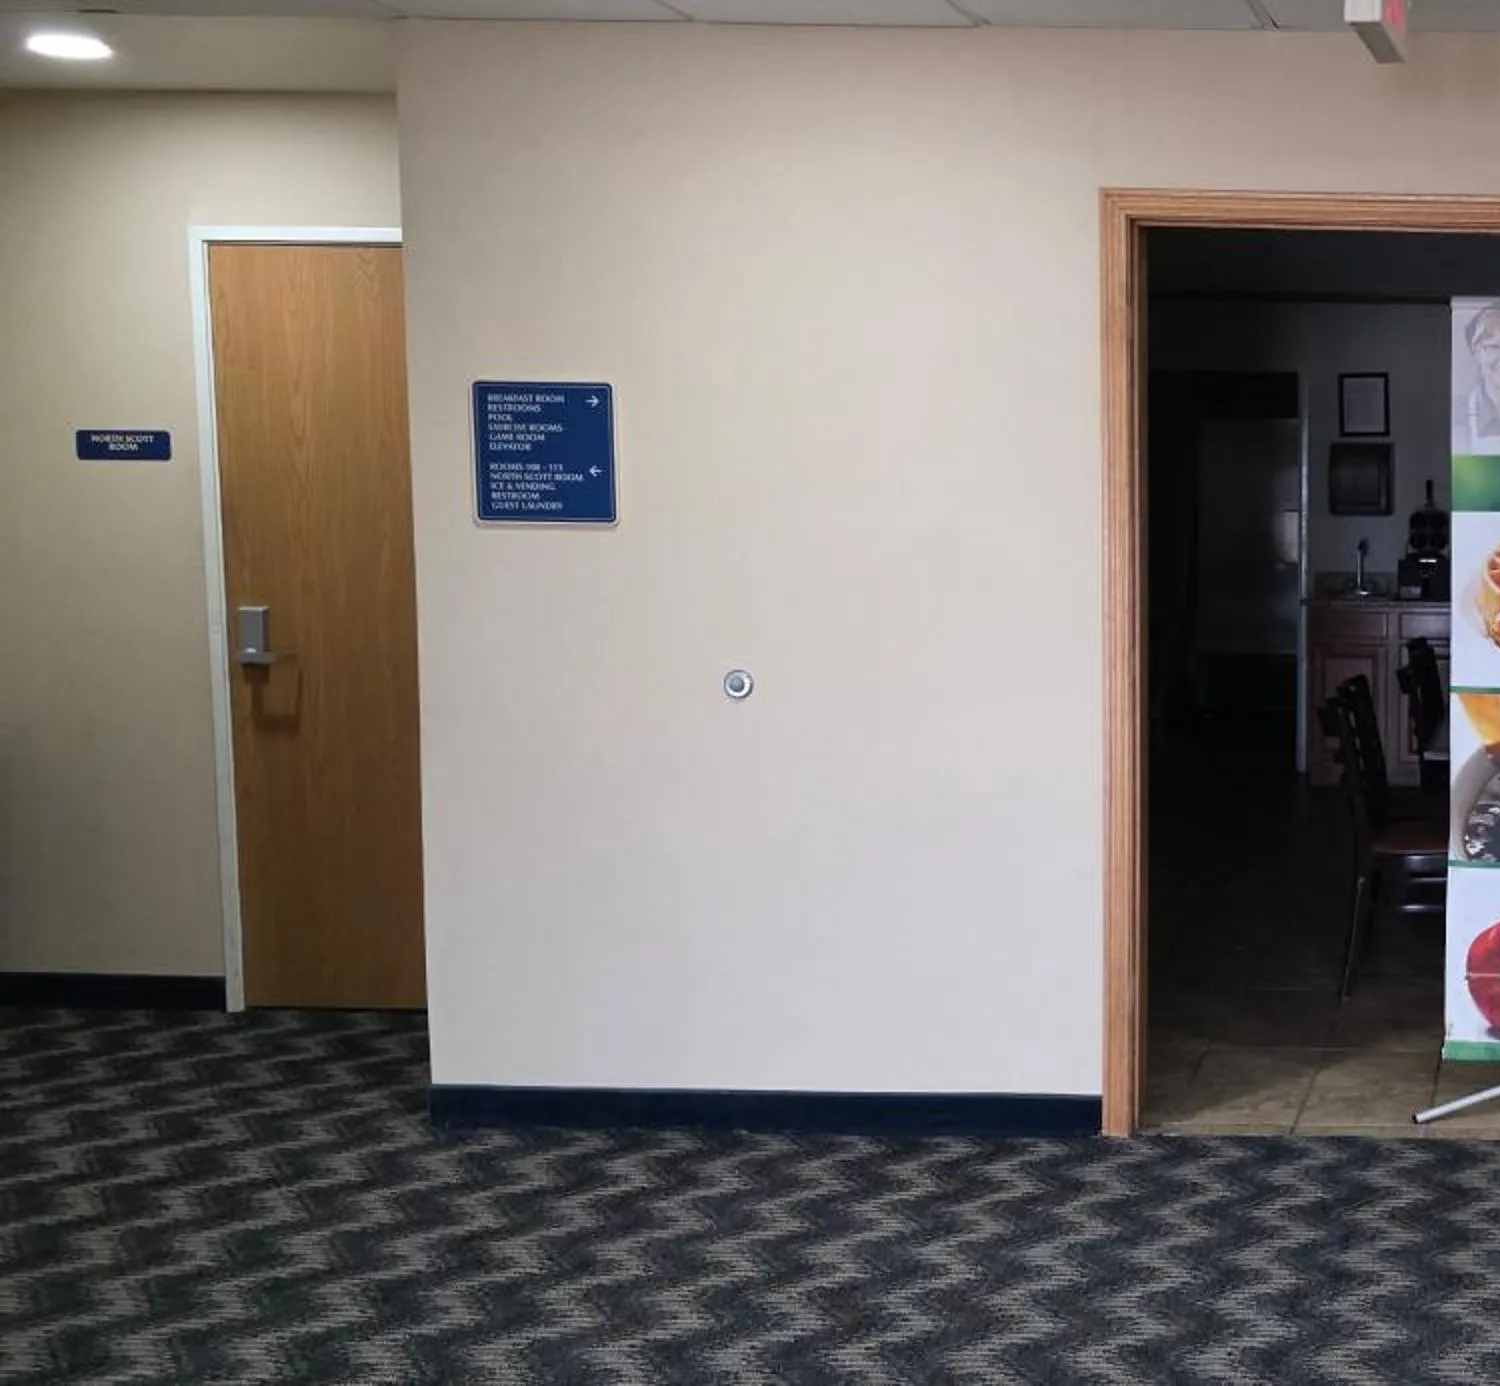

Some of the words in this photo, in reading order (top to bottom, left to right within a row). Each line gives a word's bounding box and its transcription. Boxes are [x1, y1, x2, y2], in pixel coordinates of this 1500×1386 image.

[487, 393, 533, 402] BREAKFAST
[535, 394, 565, 403] ROOM
[487, 403, 541, 413] RESTROOMS
[487, 413, 512, 421] POOL
[489, 433, 513, 441] GAME
[516, 433, 545, 441] ROOM
[108, 442, 139, 451] ROOM
[489, 442, 532, 451] ELEVATOR
[489, 463, 523, 471] ROOMS
[489, 472, 523, 481] NORTH
[524, 473, 552, 481] SCOTT
[554, 473, 583, 482] ROOM
[490, 482, 504, 490] ICE
[515, 482, 557, 491] VENDING
[491, 491, 540, 501] RESTROOM
[491, 501, 520, 510] GUEST
[521, 501, 563, 511] LAUNDRY
